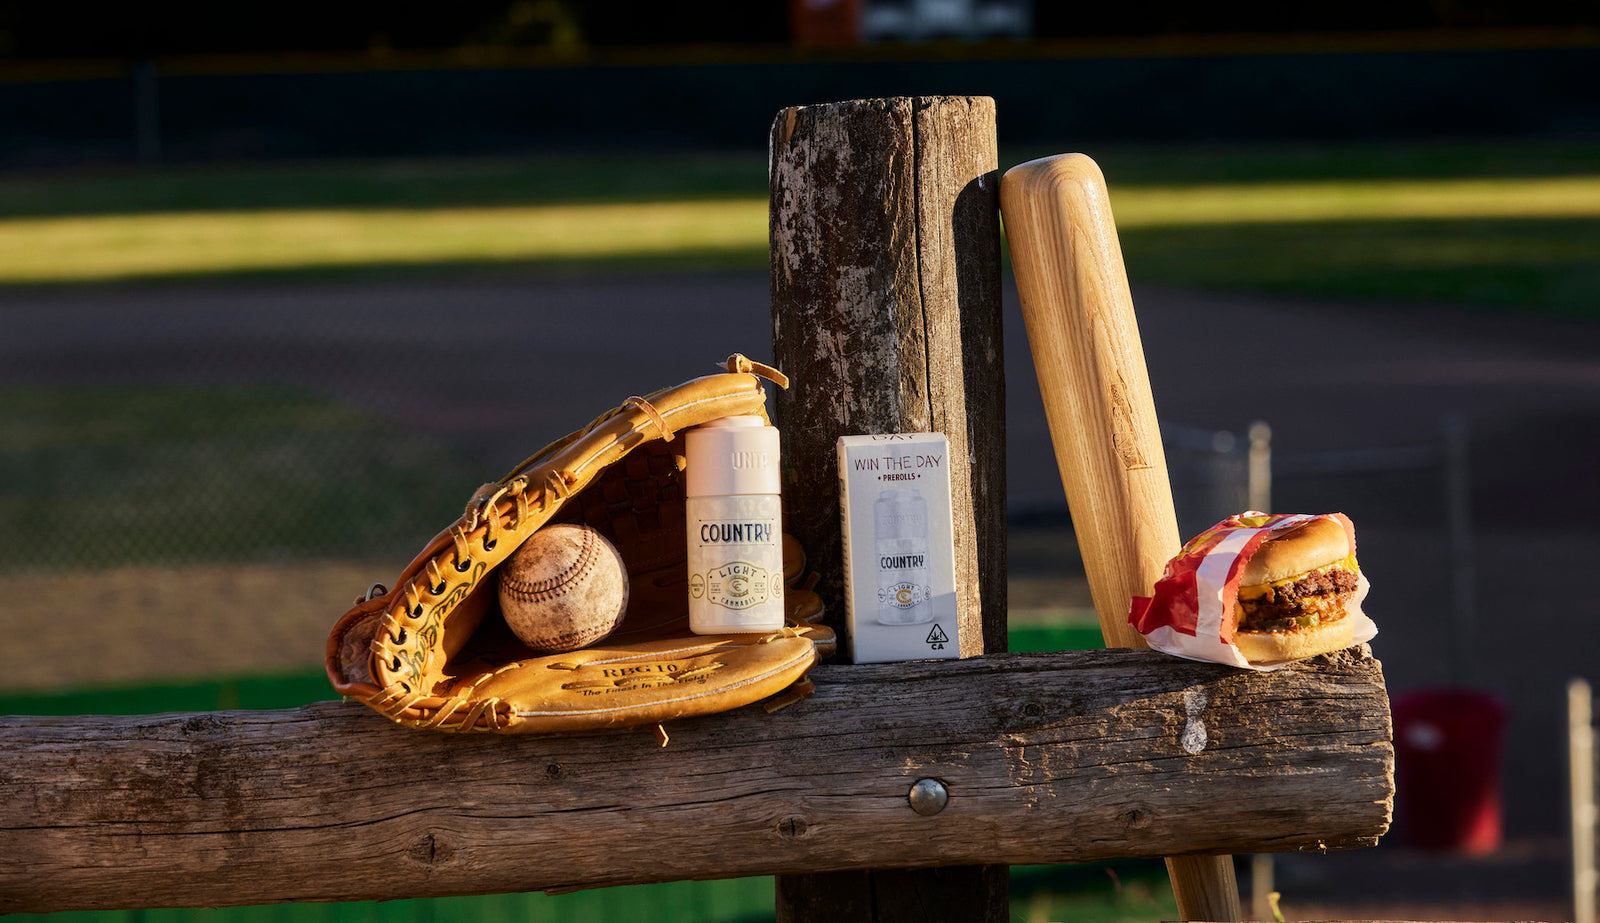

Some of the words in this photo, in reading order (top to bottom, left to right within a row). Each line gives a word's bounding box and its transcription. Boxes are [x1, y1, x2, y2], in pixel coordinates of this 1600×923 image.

[854, 457, 879, 471] WIN
[883, 455, 912, 470] THE
[916, 454, 943, 468] DAY
[882, 472, 916, 482] PREROLLS
[700, 523, 772, 543] COUNTRY
[880, 555, 924, 569] COUNTRY
[718, 565, 758, 578] LIGHT
[893, 584, 915, 592] LIGHT
[720, 596, 757, 606] CANNABIS
[602, 664, 651, 677] RBG
[657, 664, 678, 672] 10
